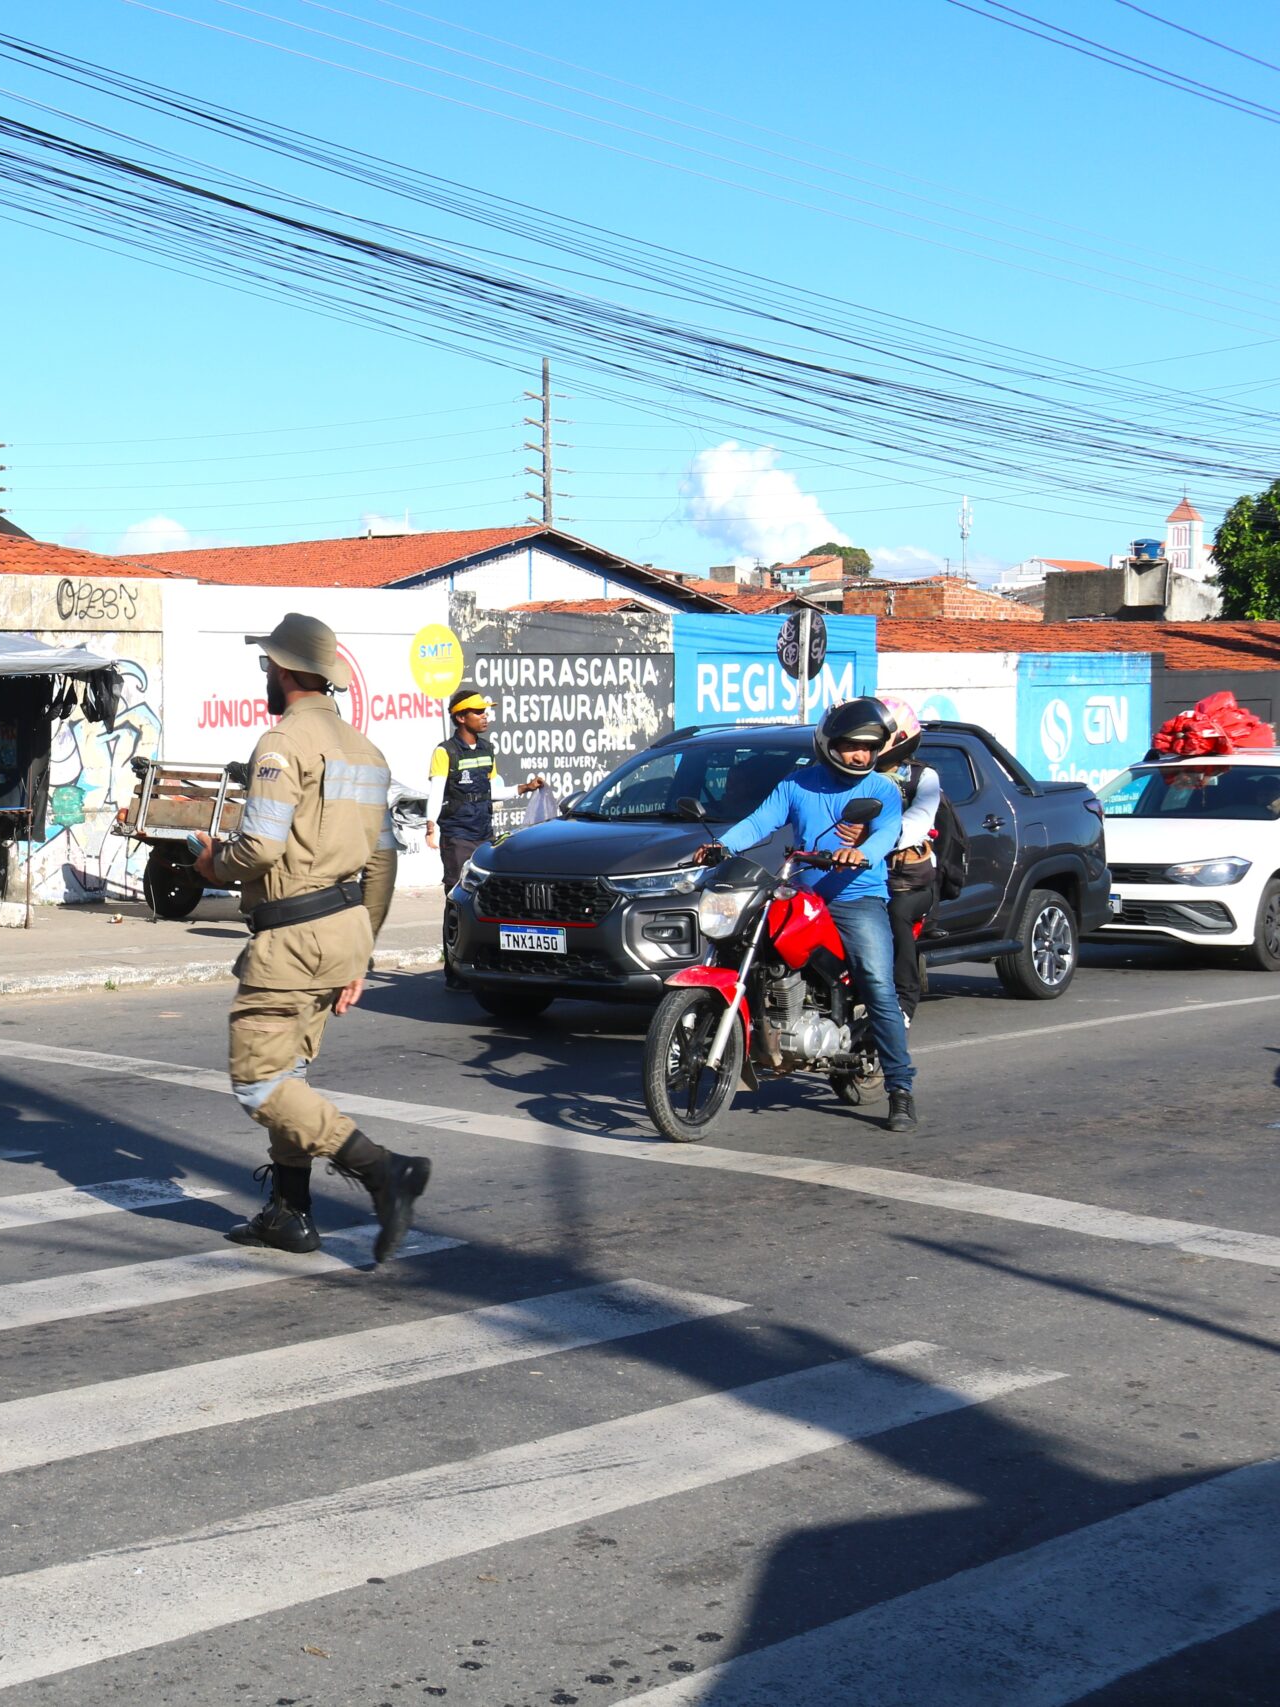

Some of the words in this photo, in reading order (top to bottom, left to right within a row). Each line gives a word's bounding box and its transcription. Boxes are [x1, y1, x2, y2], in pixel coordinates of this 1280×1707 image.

[420, 643, 453, 658] SMTT
[475, 657, 658, 687] CHURRASCARIA
[198, 694, 269, 729] JÚNIOR
[490, 729, 576, 755] SOCORRO
[257, 767, 281, 779] SMTT
[521, 757, 549, 769] NOSSO
[554, 756, 598, 769] DELIVERY
[526, 883, 554, 910] FIAT
